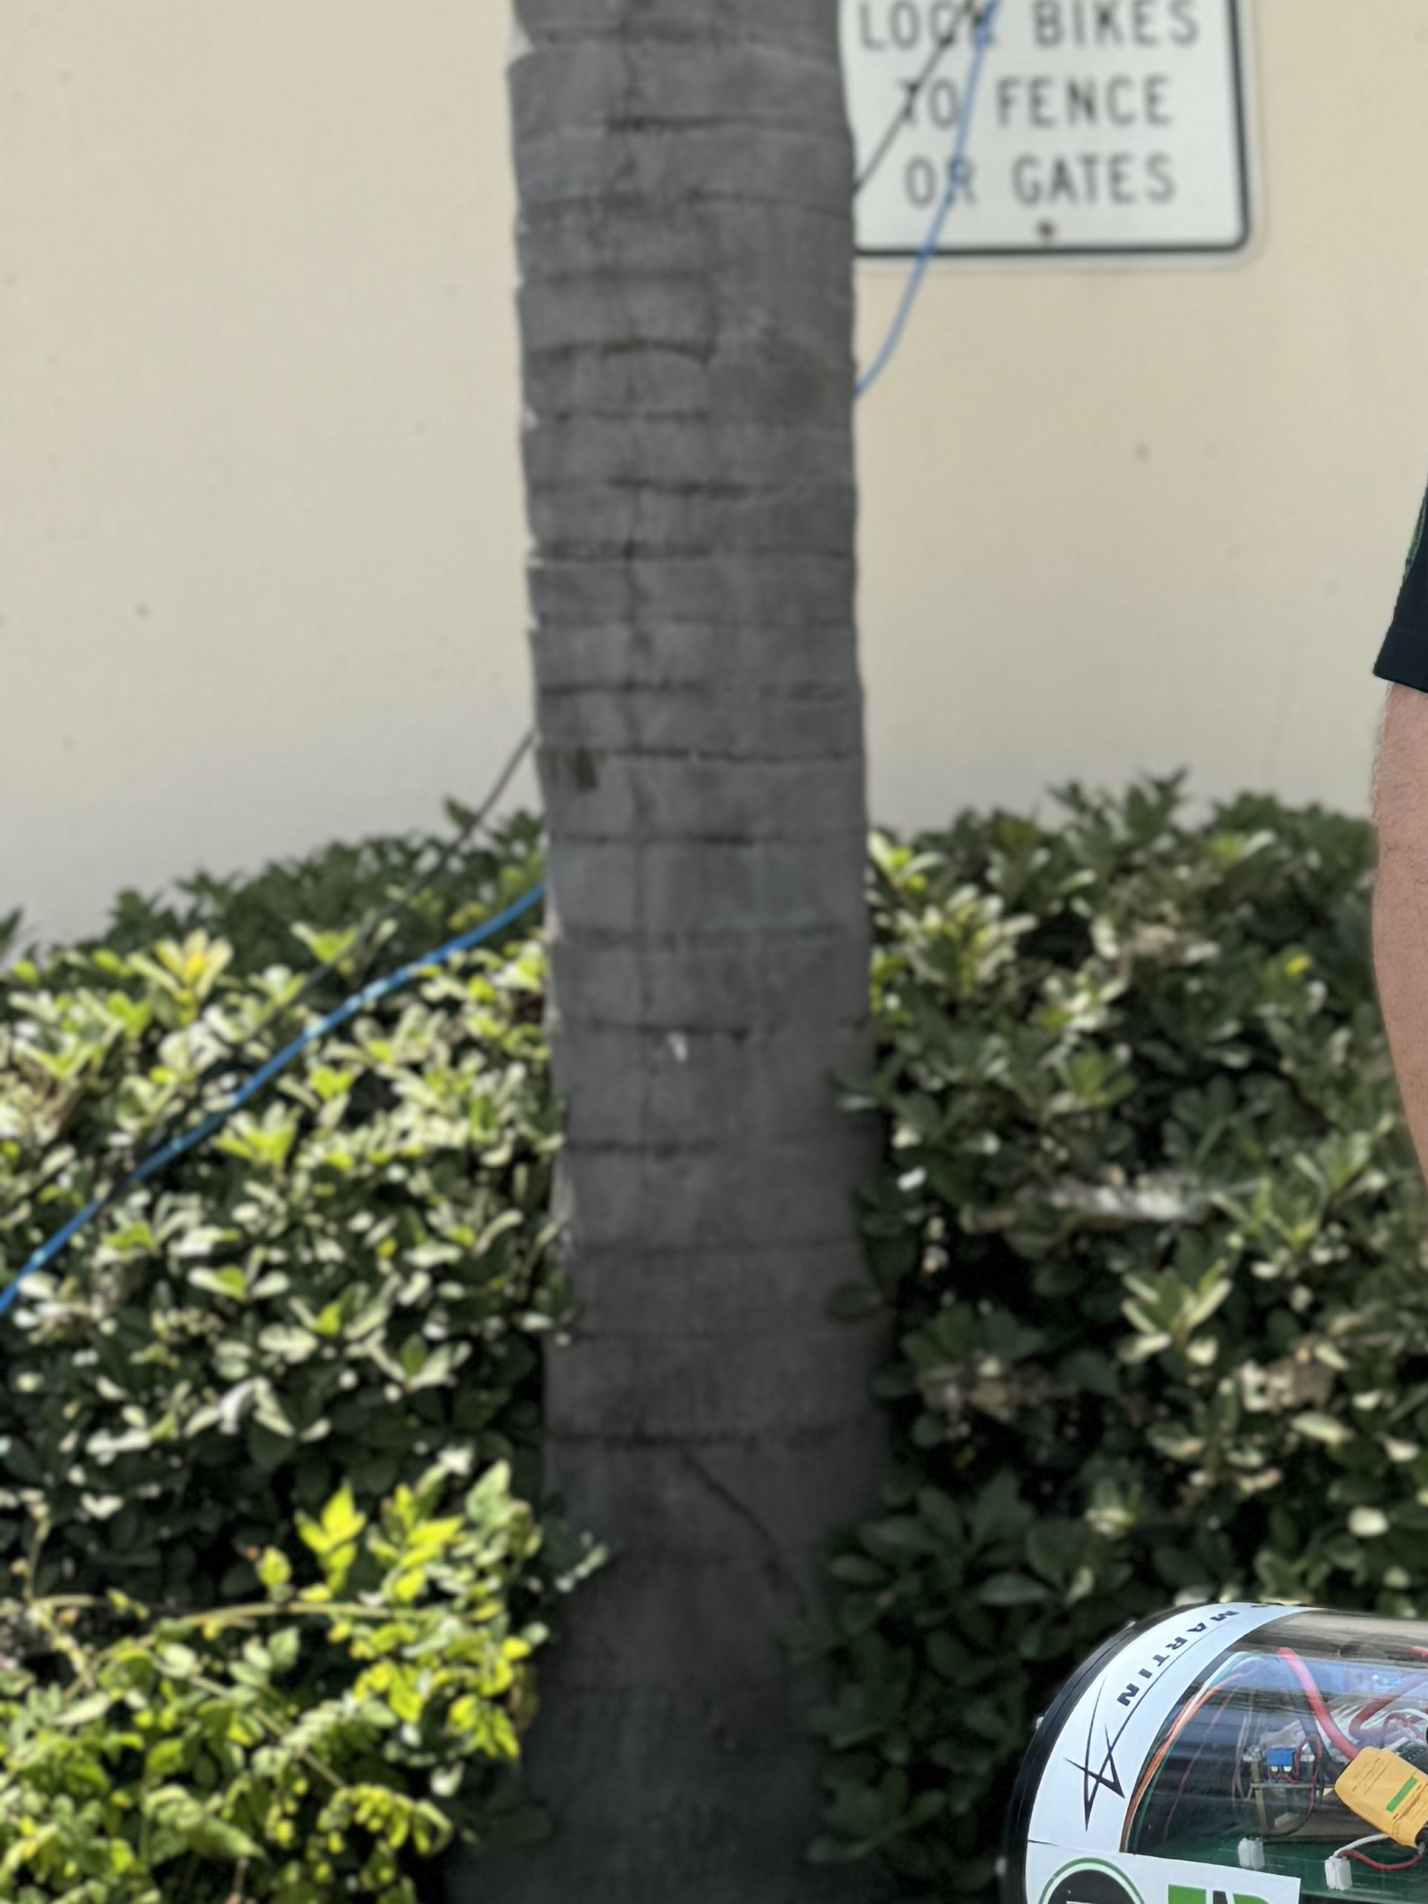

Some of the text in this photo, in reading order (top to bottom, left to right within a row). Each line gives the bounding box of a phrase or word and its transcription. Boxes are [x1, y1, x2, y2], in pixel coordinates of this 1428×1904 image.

[897, 75, 1173, 129] TO FENCE
[903, 152, 1176, 209] OR GATES
[1117, 1610, 1240, 1706] MARTIN
